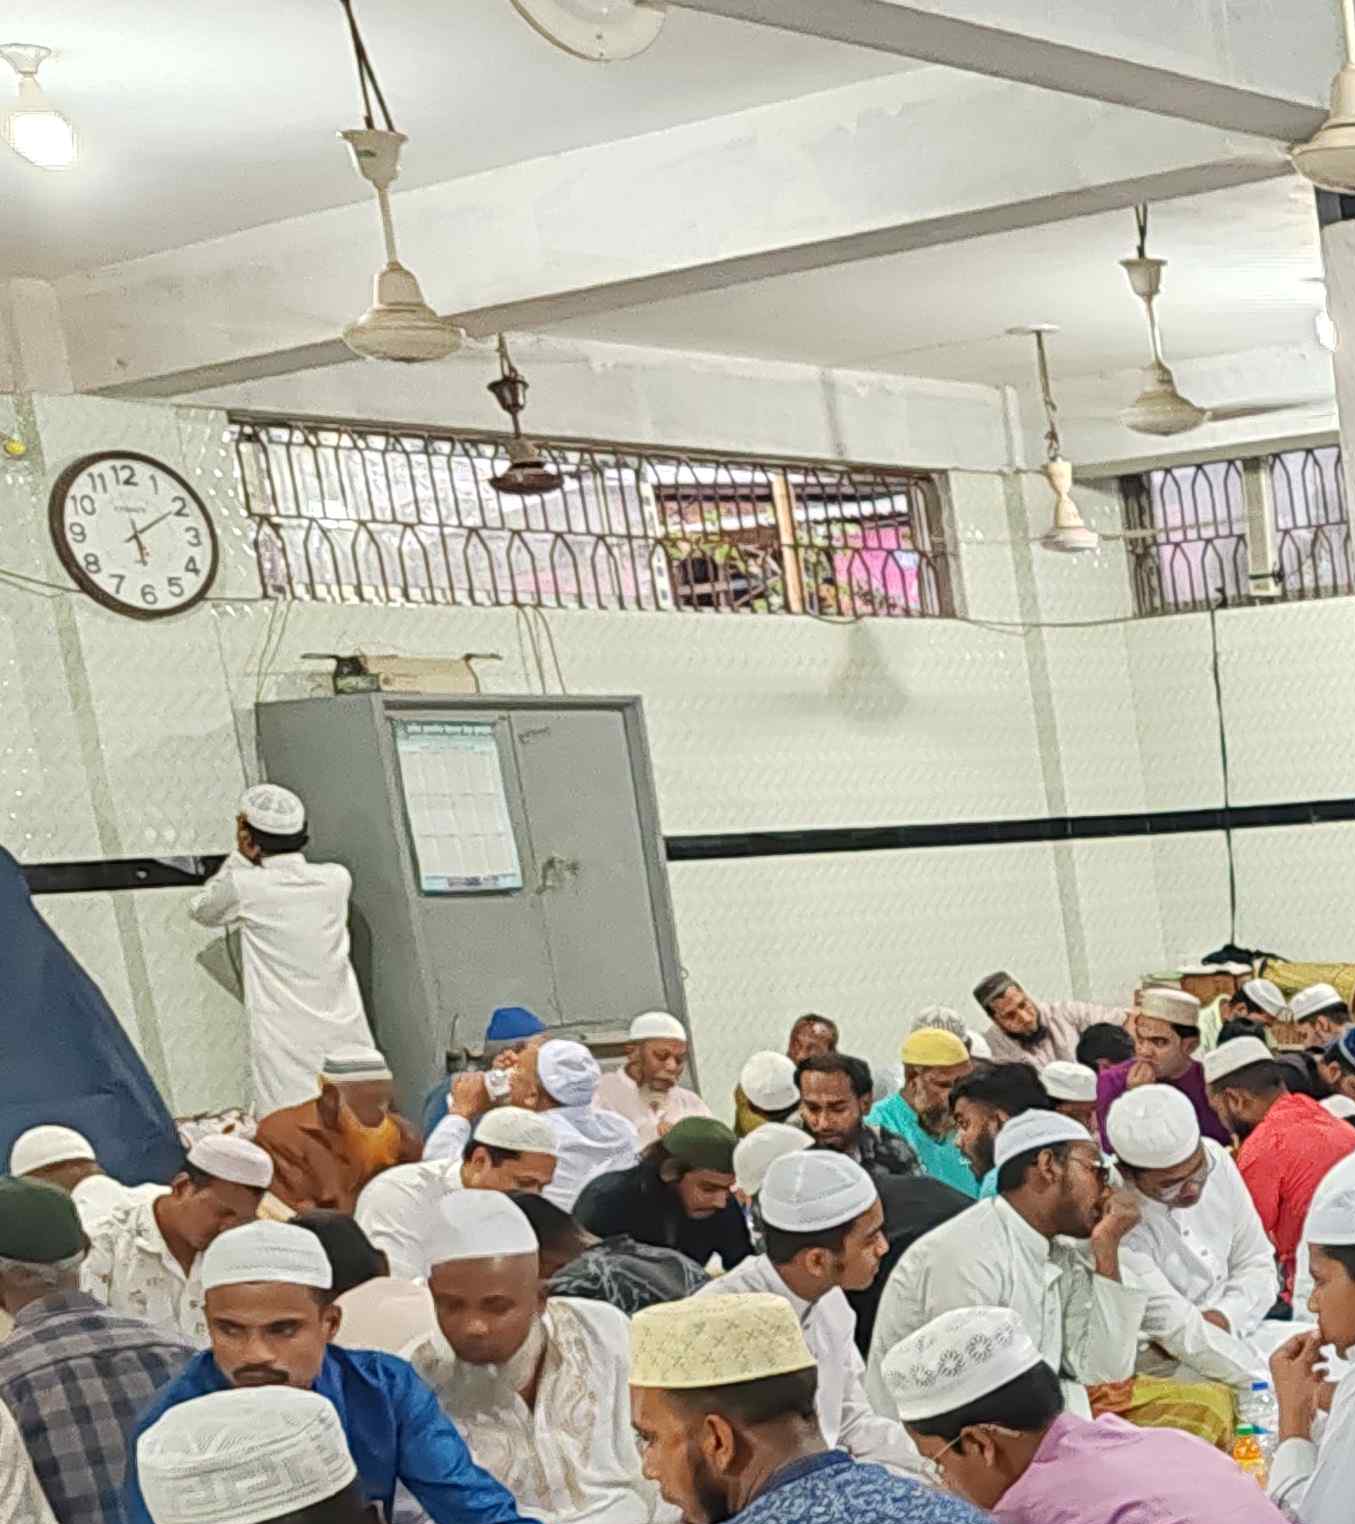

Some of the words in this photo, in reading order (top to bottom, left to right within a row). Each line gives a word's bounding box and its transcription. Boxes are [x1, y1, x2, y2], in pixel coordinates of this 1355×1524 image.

[87, 472, 107, 494] 11
[111, 465, 139, 487] 12
[149, 474, 158, 495] 1
[71, 494, 96, 516] 10
[171, 496, 190, 517] 2
[69, 522, 87, 544] 9
[185, 526, 202, 547] 3
[84, 553, 101, 573] 8
[184, 556, 200, 576] 4
[109, 574, 125, 594] 7
[141, 584, 158, 604] 6
[167, 577, 184, 597] 5
